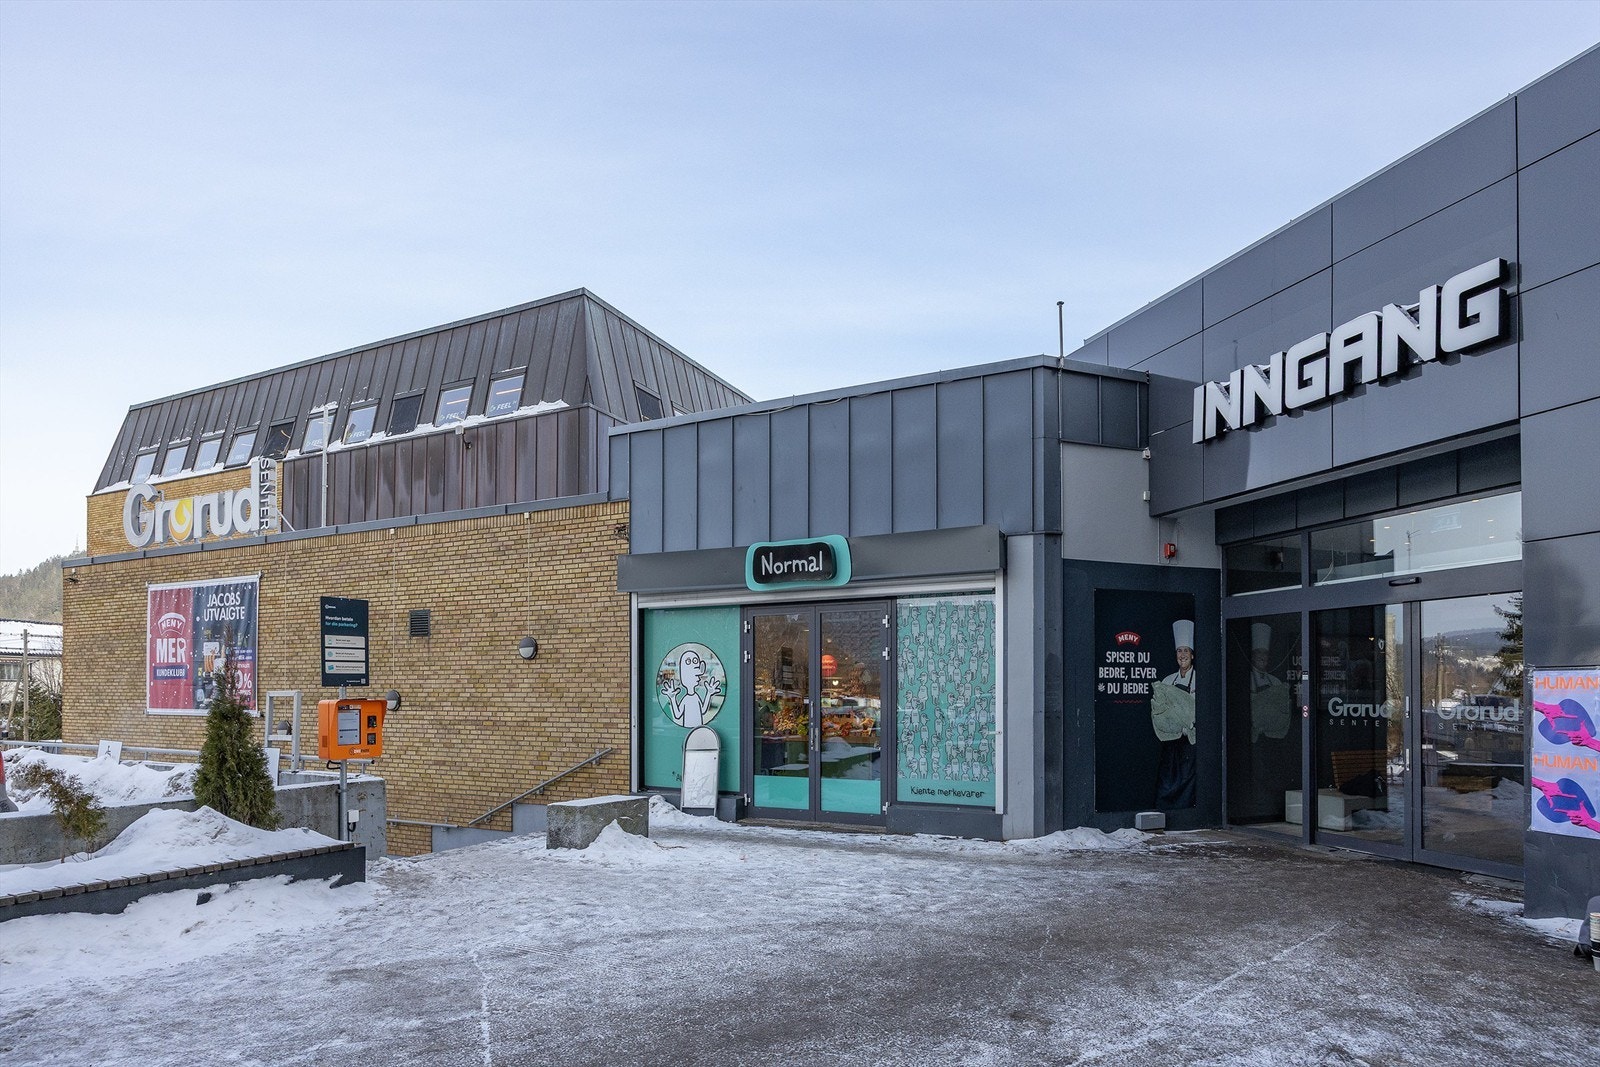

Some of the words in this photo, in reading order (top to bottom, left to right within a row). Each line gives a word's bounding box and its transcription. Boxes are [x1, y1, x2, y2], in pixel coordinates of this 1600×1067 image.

[1192, 257, 1506, 445] INNGANG
[260, 457, 270, 531] SENTER
[124, 457, 261, 548] Grorud
[761, 550, 824, 578] Normal
[207, 591, 241, 607] JACOBS
[203, 606, 245, 622] UTVALGTE
[161, 618, 183, 630] MENY
[1118, 633, 1138, 643] MENY
[156, 637, 187, 664] MER
[1105, 651, 1135, 664] SPISER
[1137, 651, 1150, 664] DU
[156, 667, 186, 677] KUNDEKLUBB
[1098, 667, 1128, 680] BEDRE,
[1130, 667, 1157, 679] LEVER
[1107, 682, 1120, 695] DU
[1122, 682, 1149, 694] BEDRE
[1535, 676, 1599, 690] HUMAN
[1437, 698, 1520, 722] Grorud
[1329, 718, 1393, 727] SENTER
[1438, 722, 1520, 732] SENTER
[1534, 756, 1598, 772] HUMAN
[937, 787, 986, 799] merkevarer
